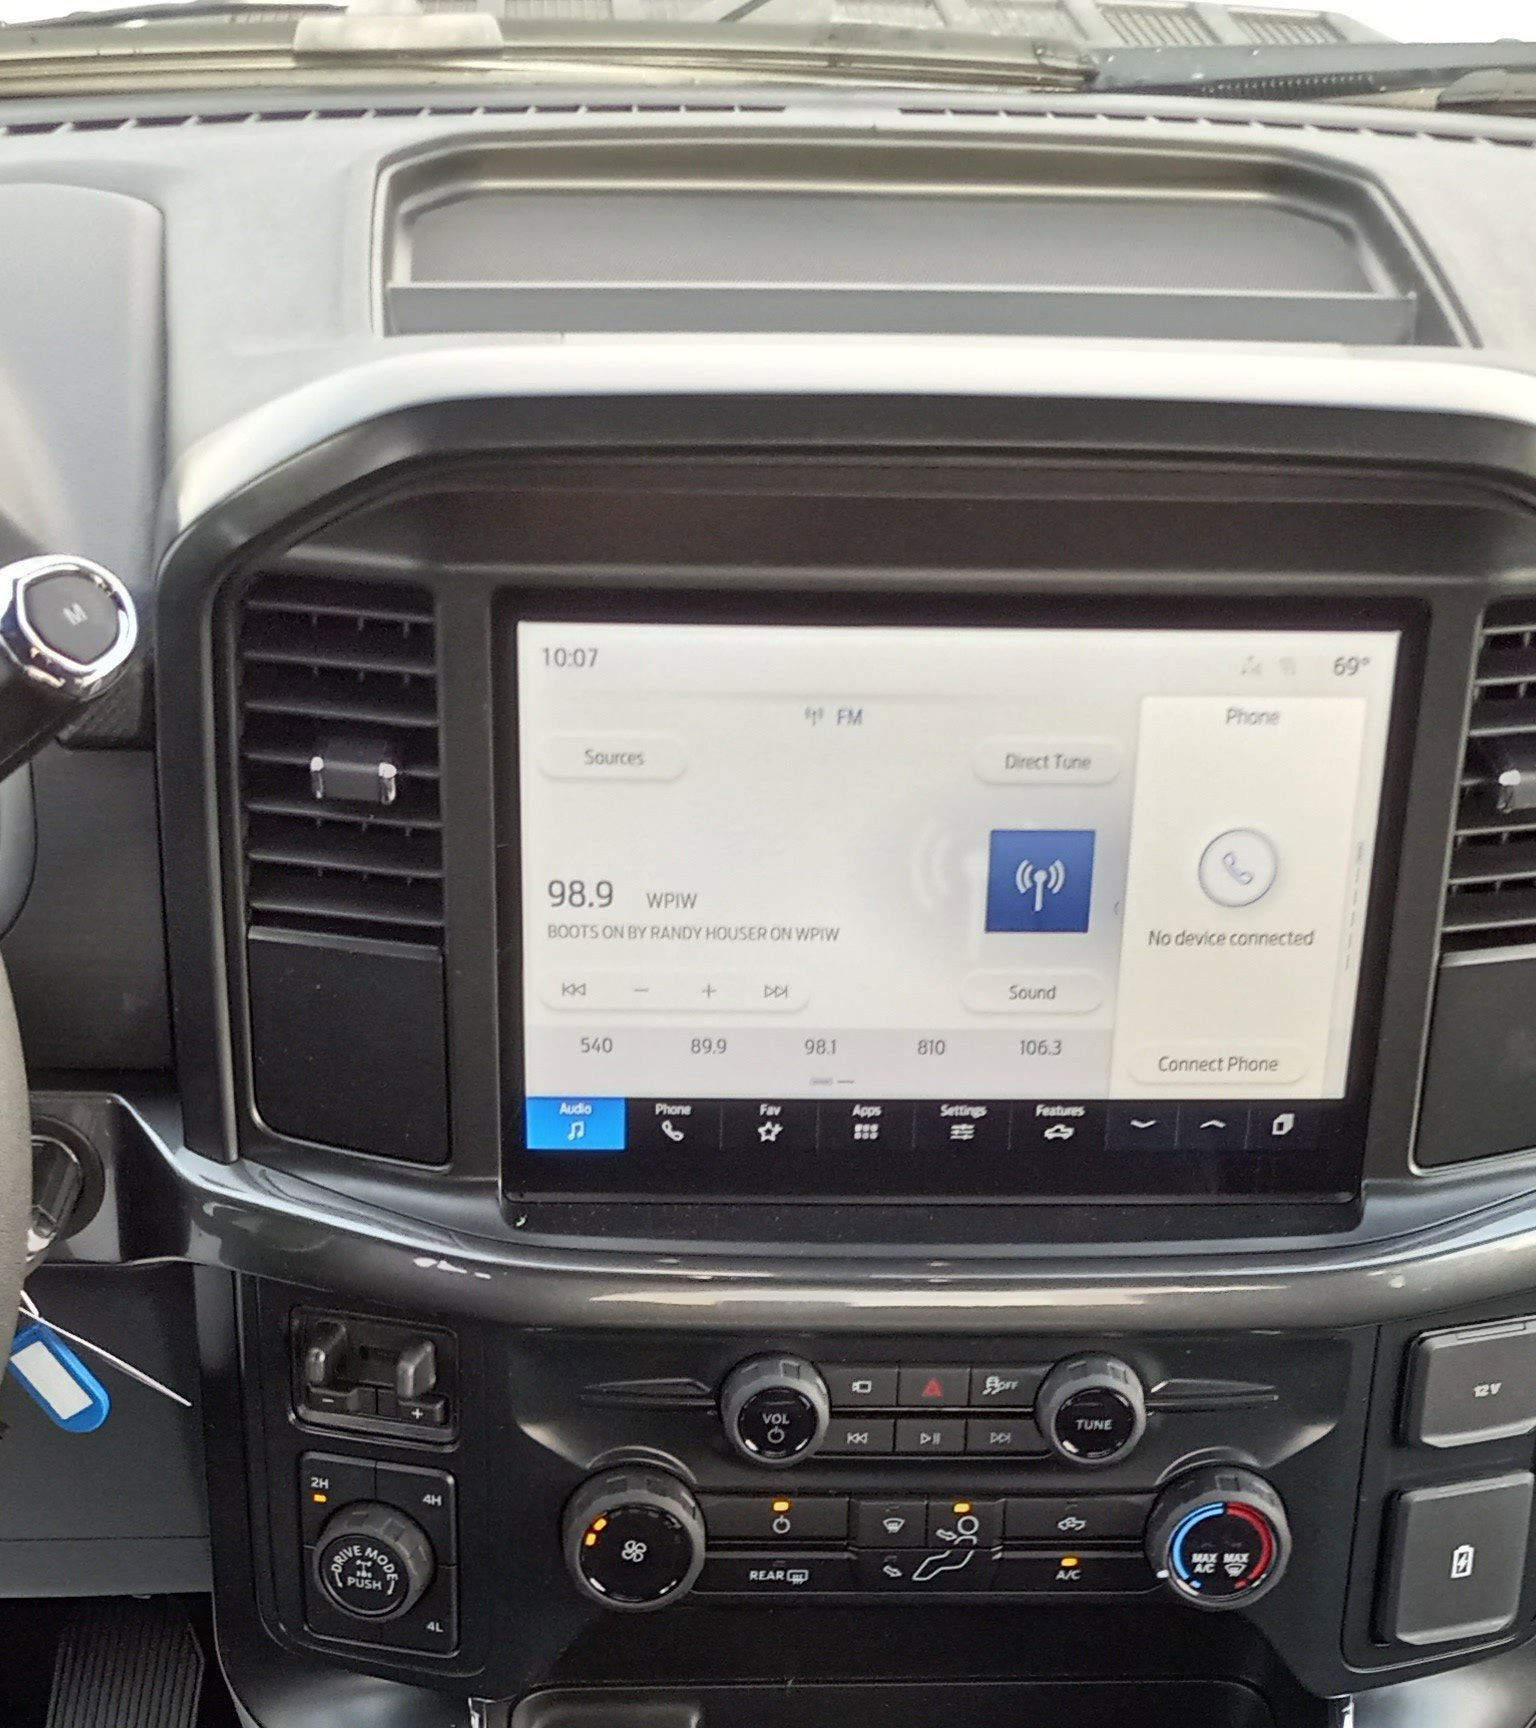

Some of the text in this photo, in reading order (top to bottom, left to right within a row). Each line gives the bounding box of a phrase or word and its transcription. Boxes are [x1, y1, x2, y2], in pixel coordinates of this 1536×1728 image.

[541, 647, 599, 668] 10:07
[836, 708, 864, 726] FM
[1225, 707, 1281, 726] Phone
[584, 748, 645, 767] Sources
[1004, 753, 1092, 771] Direct Tune
[547, 879, 614, 909] 98.9
[646, 892, 699, 910] WPIW
[547, 923, 841, 943] BOOTS ON BY RANDY HOUSER ON WPIW
[1147, 929, 1314, 947] No device connected
[1008, 984, 1057, 1001] Sound
[580, 1037, 613, 1055] 540
[690, 1037, 728, 1056] 89.9
[803, 1038, 837, 1056] 98.1
[916, 1038, 946, 1056] 810
[1018, 1039, 1062, 1057] 106.3
[1157, 1056, 1279, 1073] Connect Phone
[559, 1102, 592, 1117] Audio
[654, 1102, 692, 1117] Phone
[759, 1103, 782, 1117] Fav
[851, 1104, 883, 1119] Apps
[939, 1104, 988, 1119] Settings
[1034, 1104, 1086, 1118] Features
[762, 1412, 790, 1425] VOL
[1075, 1418, 1113, 1431] TUNE
[310, 1477, 330, 1490] 2H
[421, 1493, 443, 1507] 4H
[330, 1544, 399, 1581] DRIVE MODE
[1191, 1552, 1219, 1563] MAX
[1223, 1552, 1250, 1563] MAX
[749, 1569, 785, 1582] REAR
[1055, 1568, 1082, 1582] A/C
[1192, 1562, 1216, 1574] A/C
[346, 1576, 383, 1591] PUSH
[425, 1620, 444, 1633] 4L
